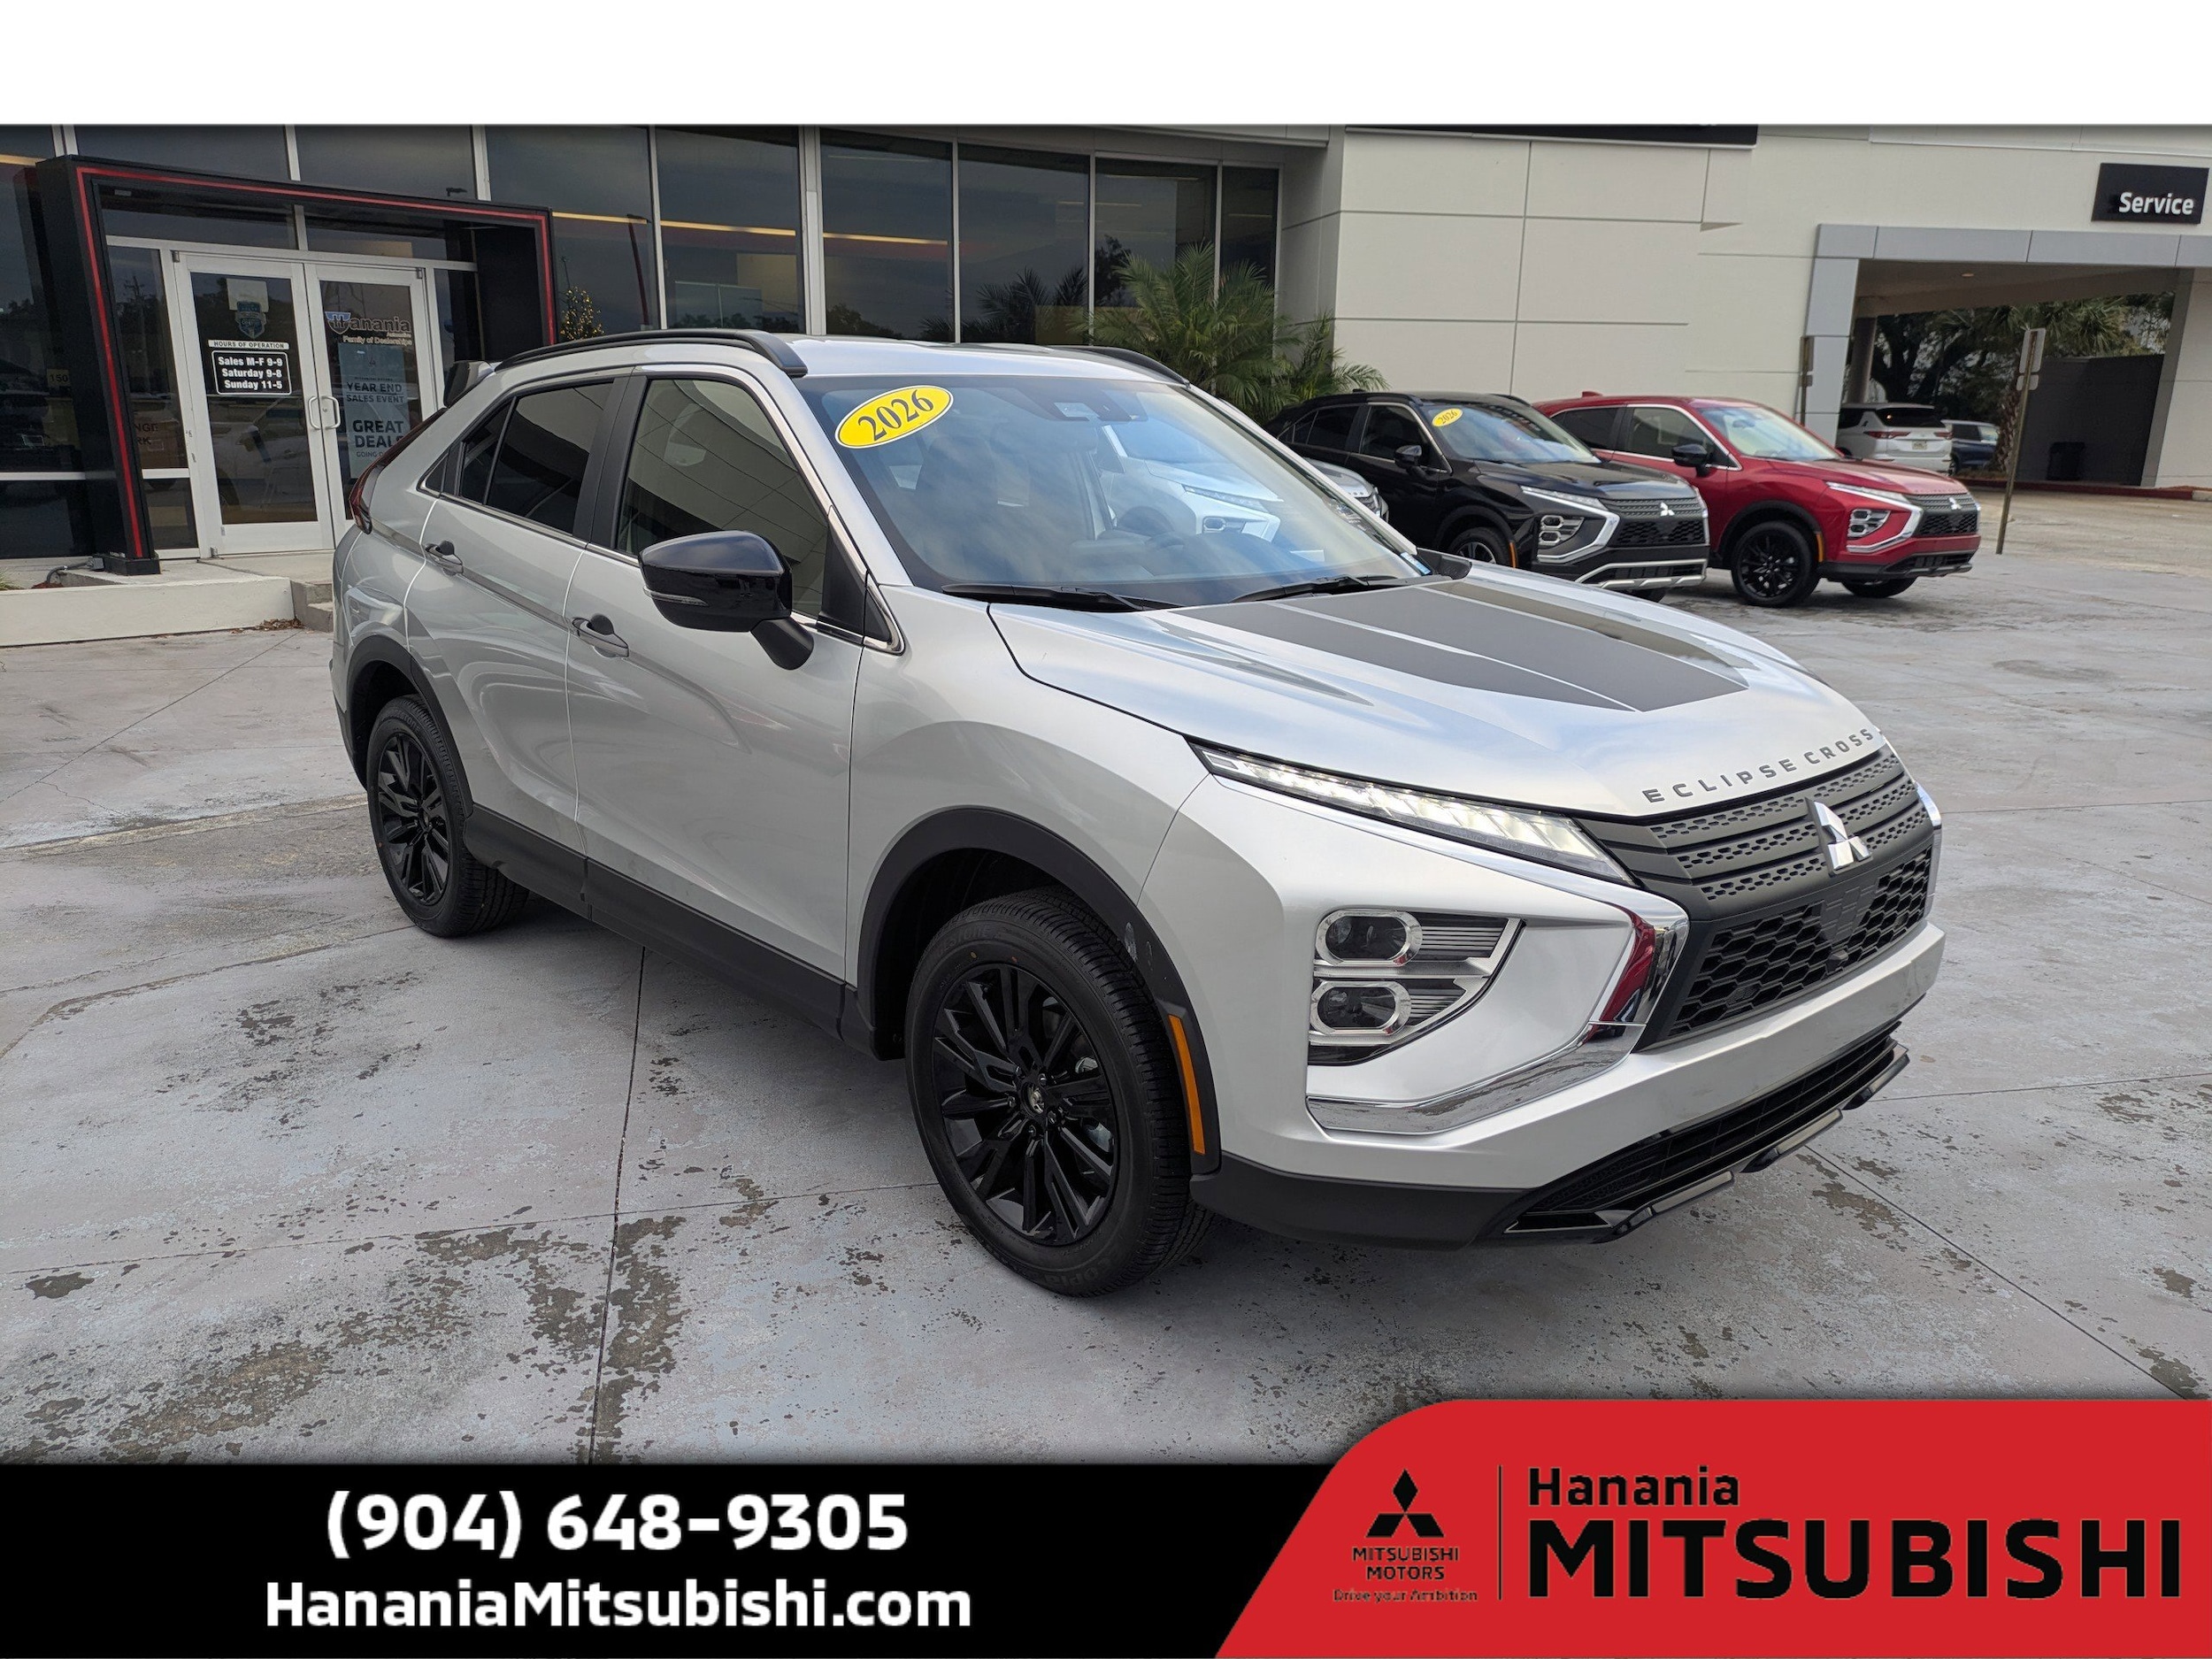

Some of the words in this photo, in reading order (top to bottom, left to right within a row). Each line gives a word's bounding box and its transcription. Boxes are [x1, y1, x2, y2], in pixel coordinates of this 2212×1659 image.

[2118, 191, 2194, 215] Service
[342, 334, 365, 345] Family
[374, 336, 413, 346] Dealerships
[218, 356, 244, 366] Sales
[246, 357, 265, 366] M-F
[266, 357, 283, 366] 9-9
[49, 373, 69, 383] 150
[221, 367, 264, 380] Saturday
[265, 369, 282, 378] 9-8
[224, 380, 258, 390] Sunday
[261, 380, 282, 389] 11-5
[347, 382, 377, 393] YEAR
[380, 383, 403, 393] END
[347, 394, 374, 403] SALES
[377, 395, 404, 403] EVENT
[857, 389, 934, 442] 2026
[352, 419, 404, 434] GREAT
[1641, 758, 1798, 803] ECLIPSE
[1803, 728, 1874, 764] CROSS
